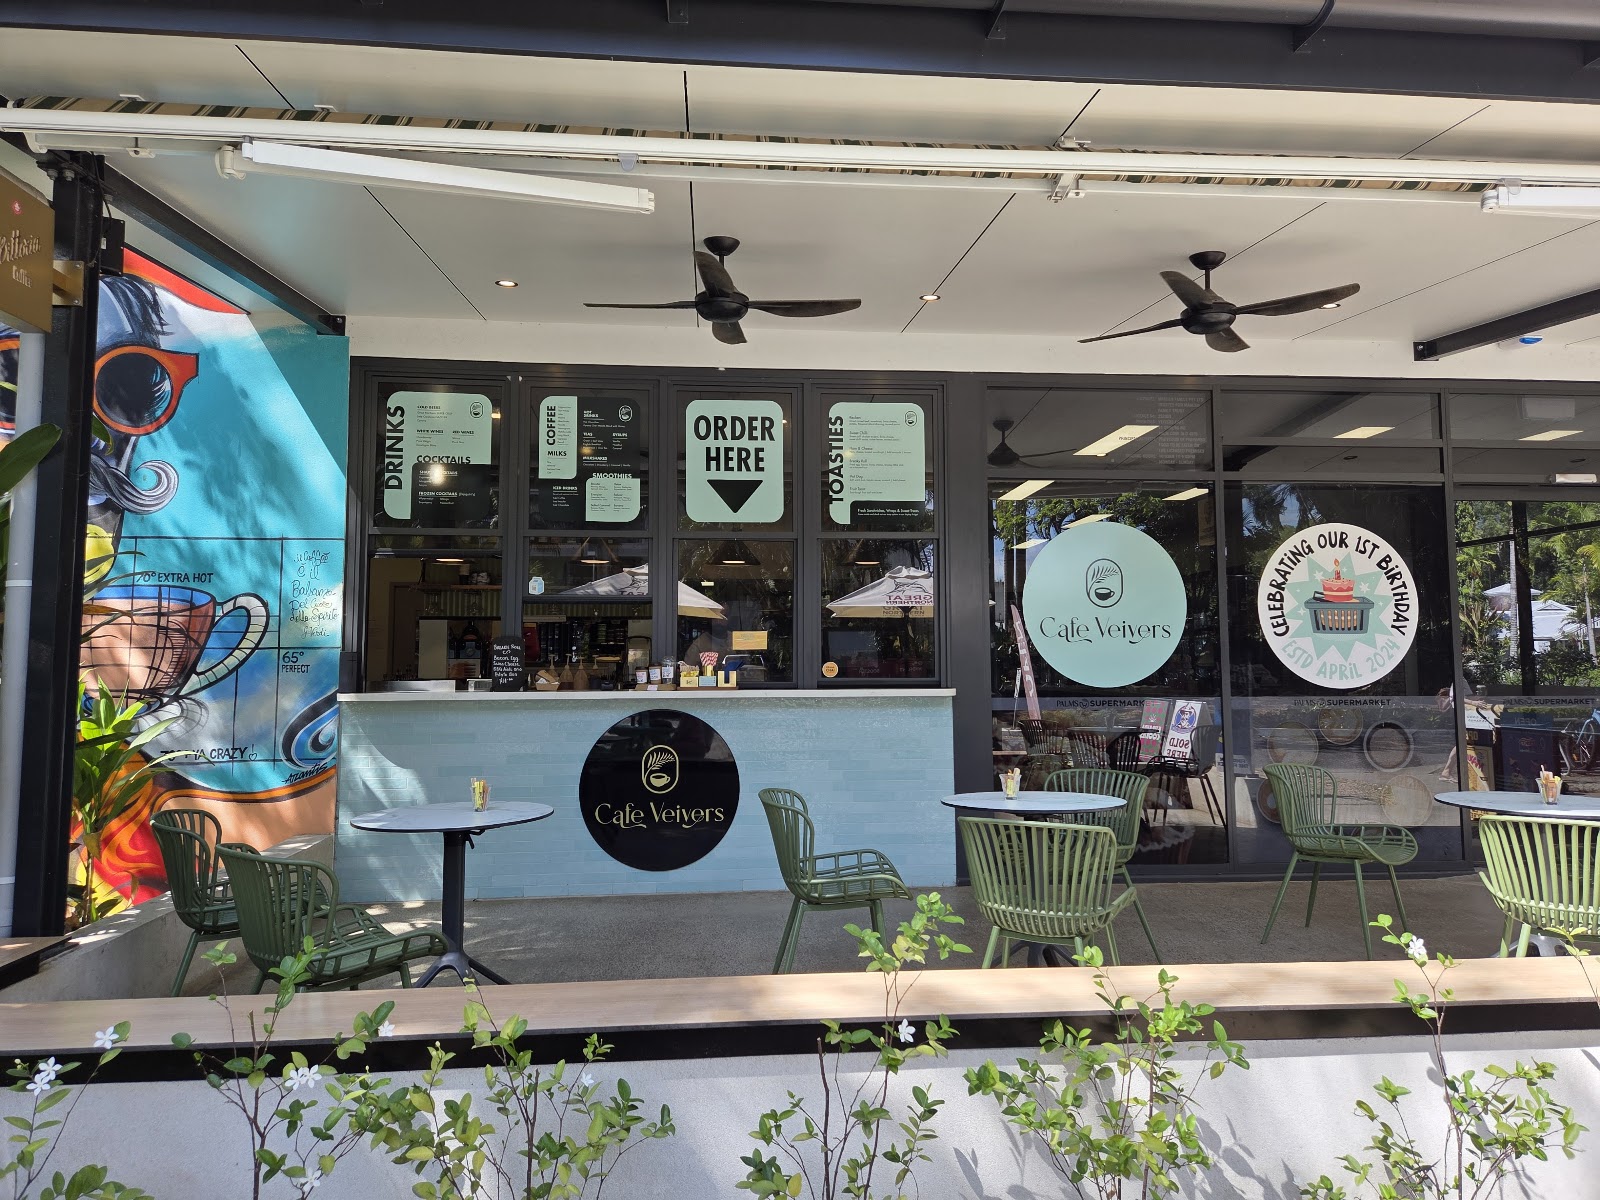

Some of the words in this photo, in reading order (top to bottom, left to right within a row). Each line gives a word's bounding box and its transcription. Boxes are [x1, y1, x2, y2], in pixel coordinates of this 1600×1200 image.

[546, 406, 556, 445] COFFEE
[694, 415, 775, 441] ORDER
[384, 406, 405, 490] DRINKS
[416, 455, 471, 464] COCKTAILS
[706, 447, 765, 472] HERE
[828, 416, 844, 504] TOASTIES
[1317, 531, 1349, 549] OUR
[1355, 536, 1380, 559] 1ST
[158, 572, 190, 583] EXTRA
[193, 573, 214, 583] HOT
[1040, 616, 1093, 643] Cafe
[1095, 616, 1171, 644] Veivers
[282, 651, 304, 664] 65°
[1281, 639, 1314, 669] ESTD
[1366, 638, 1401, 673] 2024
[282, 664, 310, 673] PERFECT
[595, 803, 647, 828] Cafe
[650, 802, 724, 828] Veivers
